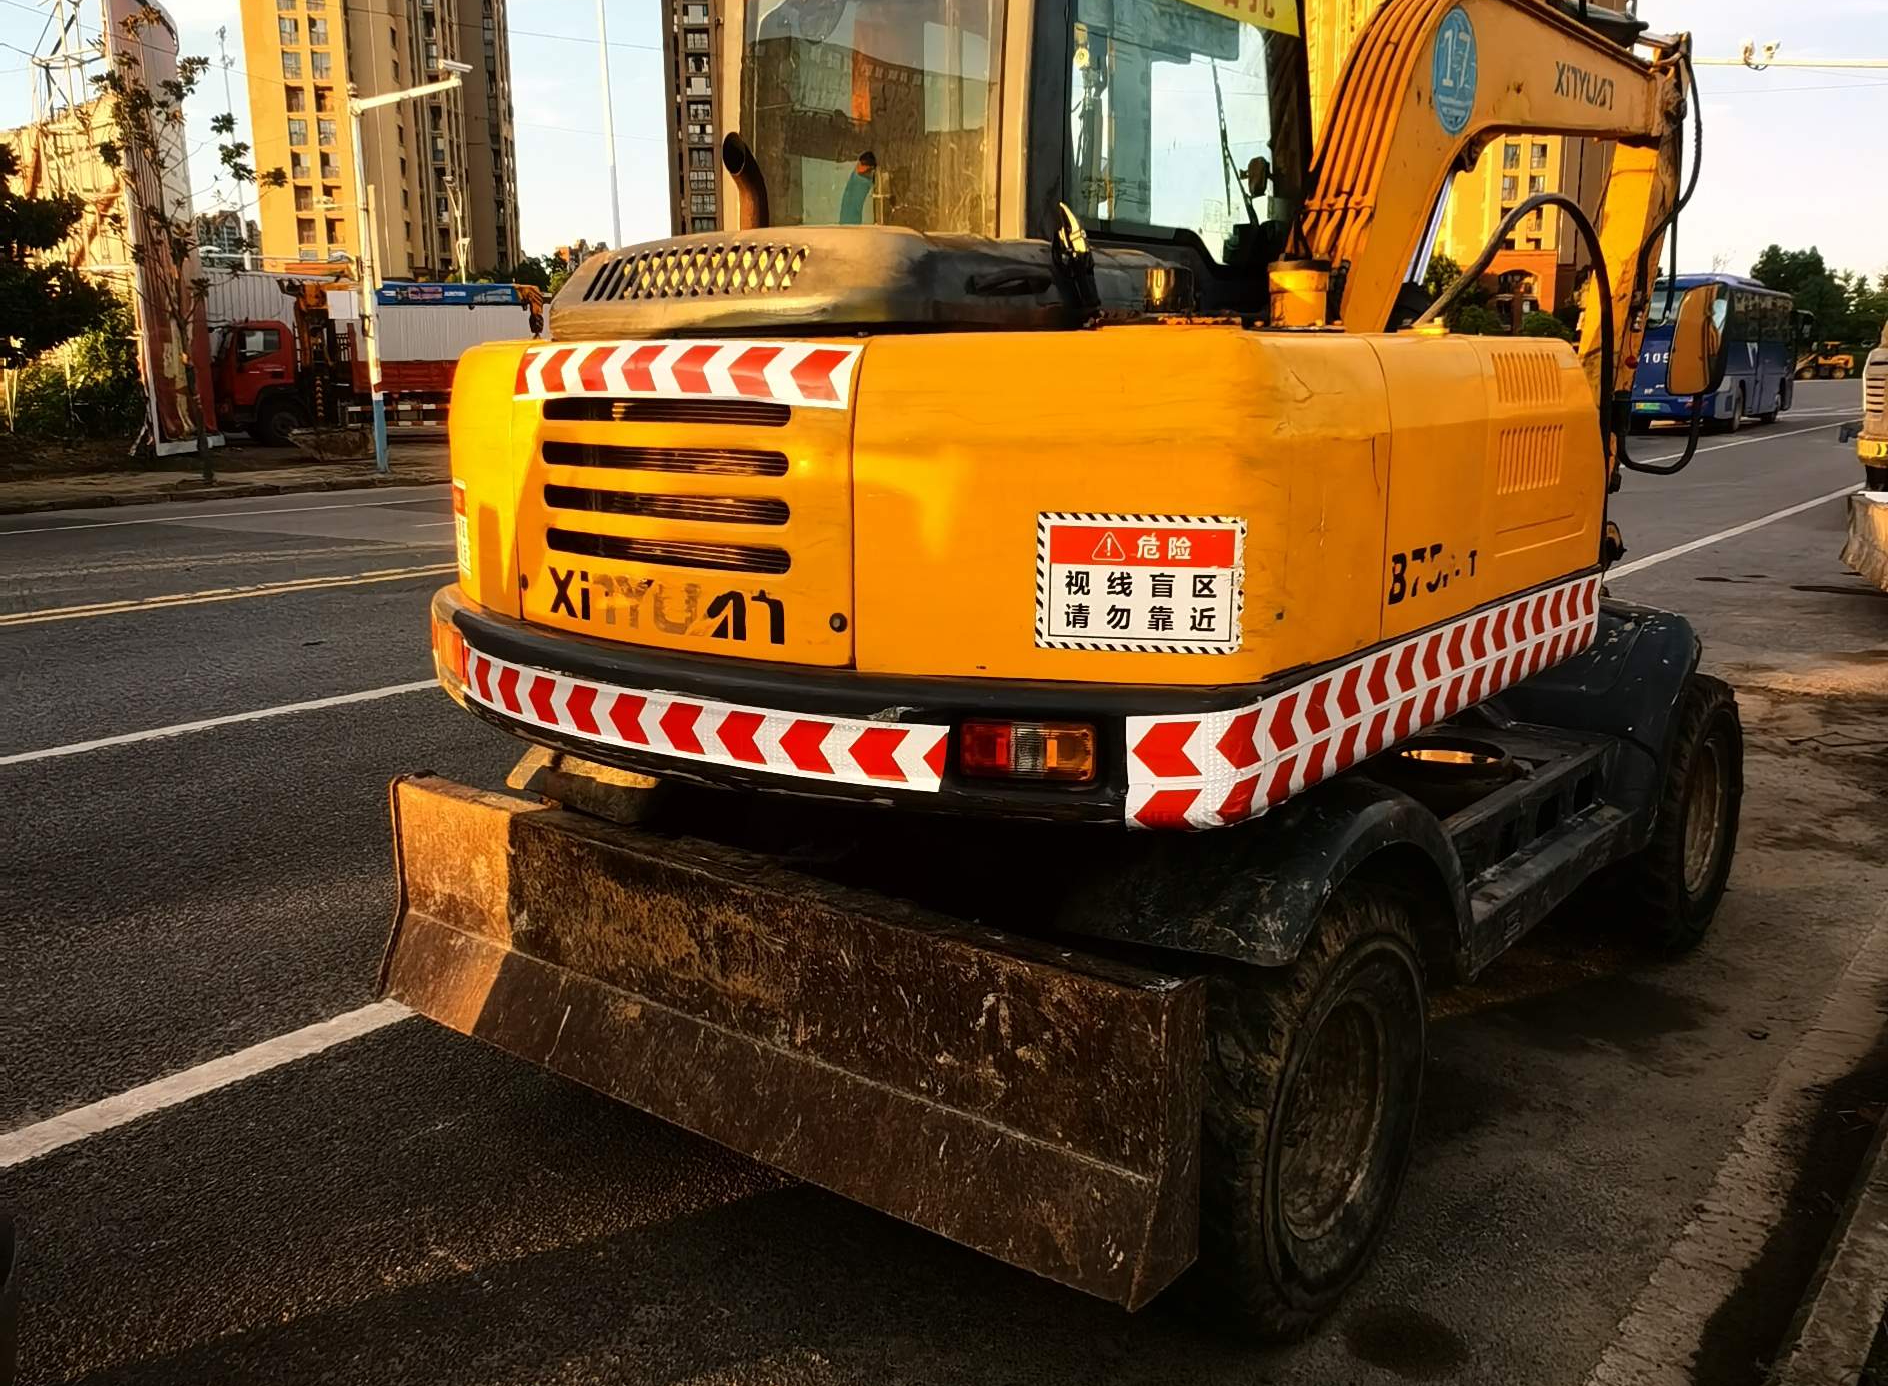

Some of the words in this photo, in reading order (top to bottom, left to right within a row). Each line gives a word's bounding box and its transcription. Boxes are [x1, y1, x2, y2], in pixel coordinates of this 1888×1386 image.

[1135, 532, 1193, 561] 危险
[1064, 569, 1218, 599] 视线盲区
[1063, 602, 1217, 633] 请勿靠近
